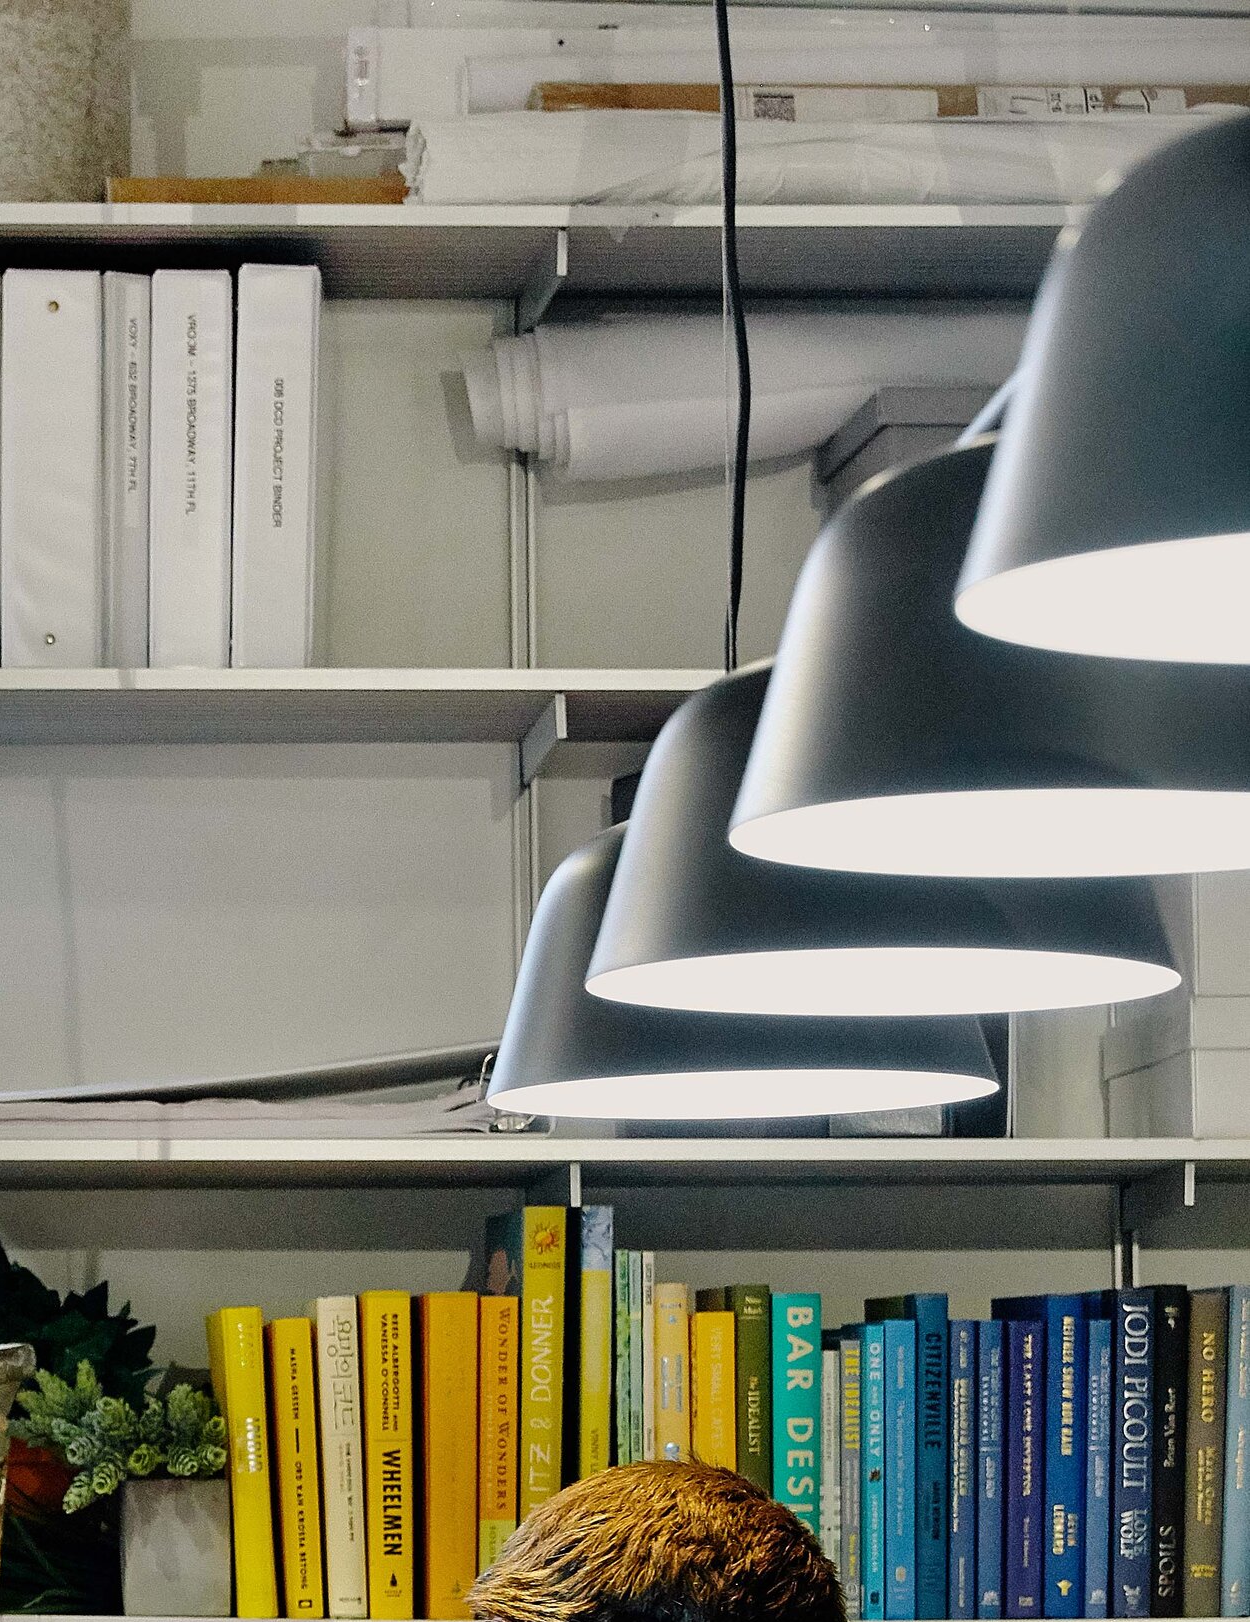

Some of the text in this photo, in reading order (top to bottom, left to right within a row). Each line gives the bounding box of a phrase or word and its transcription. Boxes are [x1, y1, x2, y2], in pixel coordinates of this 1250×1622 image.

[273, 429, 284, 481] PROJECT
[185, 500, 196, 515] FL
[272, 485, 283, 528] BINDER
[380, 1313, 390, 1364] VANESSA
[391, 1313, 400, 1340] REED
[498, 1306, 512, 1386] WONDER
[529, 1295, 554, 1402] DONNER
[786, 1306, 815, 1391] BAR
[1022, 1335, 1033, 1359] THE
[289, 1348, 299, 1381] MASHA
[391, 1343, 401, 1410] ALBERGOTTI
[844, 1349, 860, 1376] THE
[869, 1342, 881, 1381] ONE
[1200, 1331, 1216, 1423] NO HERO
[844, 1382, 860, 1449] IDEALIST
[925, 1332, 942, 1450] CITIZENVILLE
[1122, 1303, 1150, 1493] JODI PICOULT
[747, 1390, 761, 1456] IDEALIST
[869, 1409, 881, 1457] ONLY
[294, 1461, 304, 1482] ORD
[496, 1421, 512, 1511] WONDERS
[382, 1449, 404, 1556] WHEELMEN
[1120, 1510, 1135, 1560] WOLF
[1133, 1509, 1148, 1556] LONE
[1158, 1525, 1176, 1598] SPOILS
